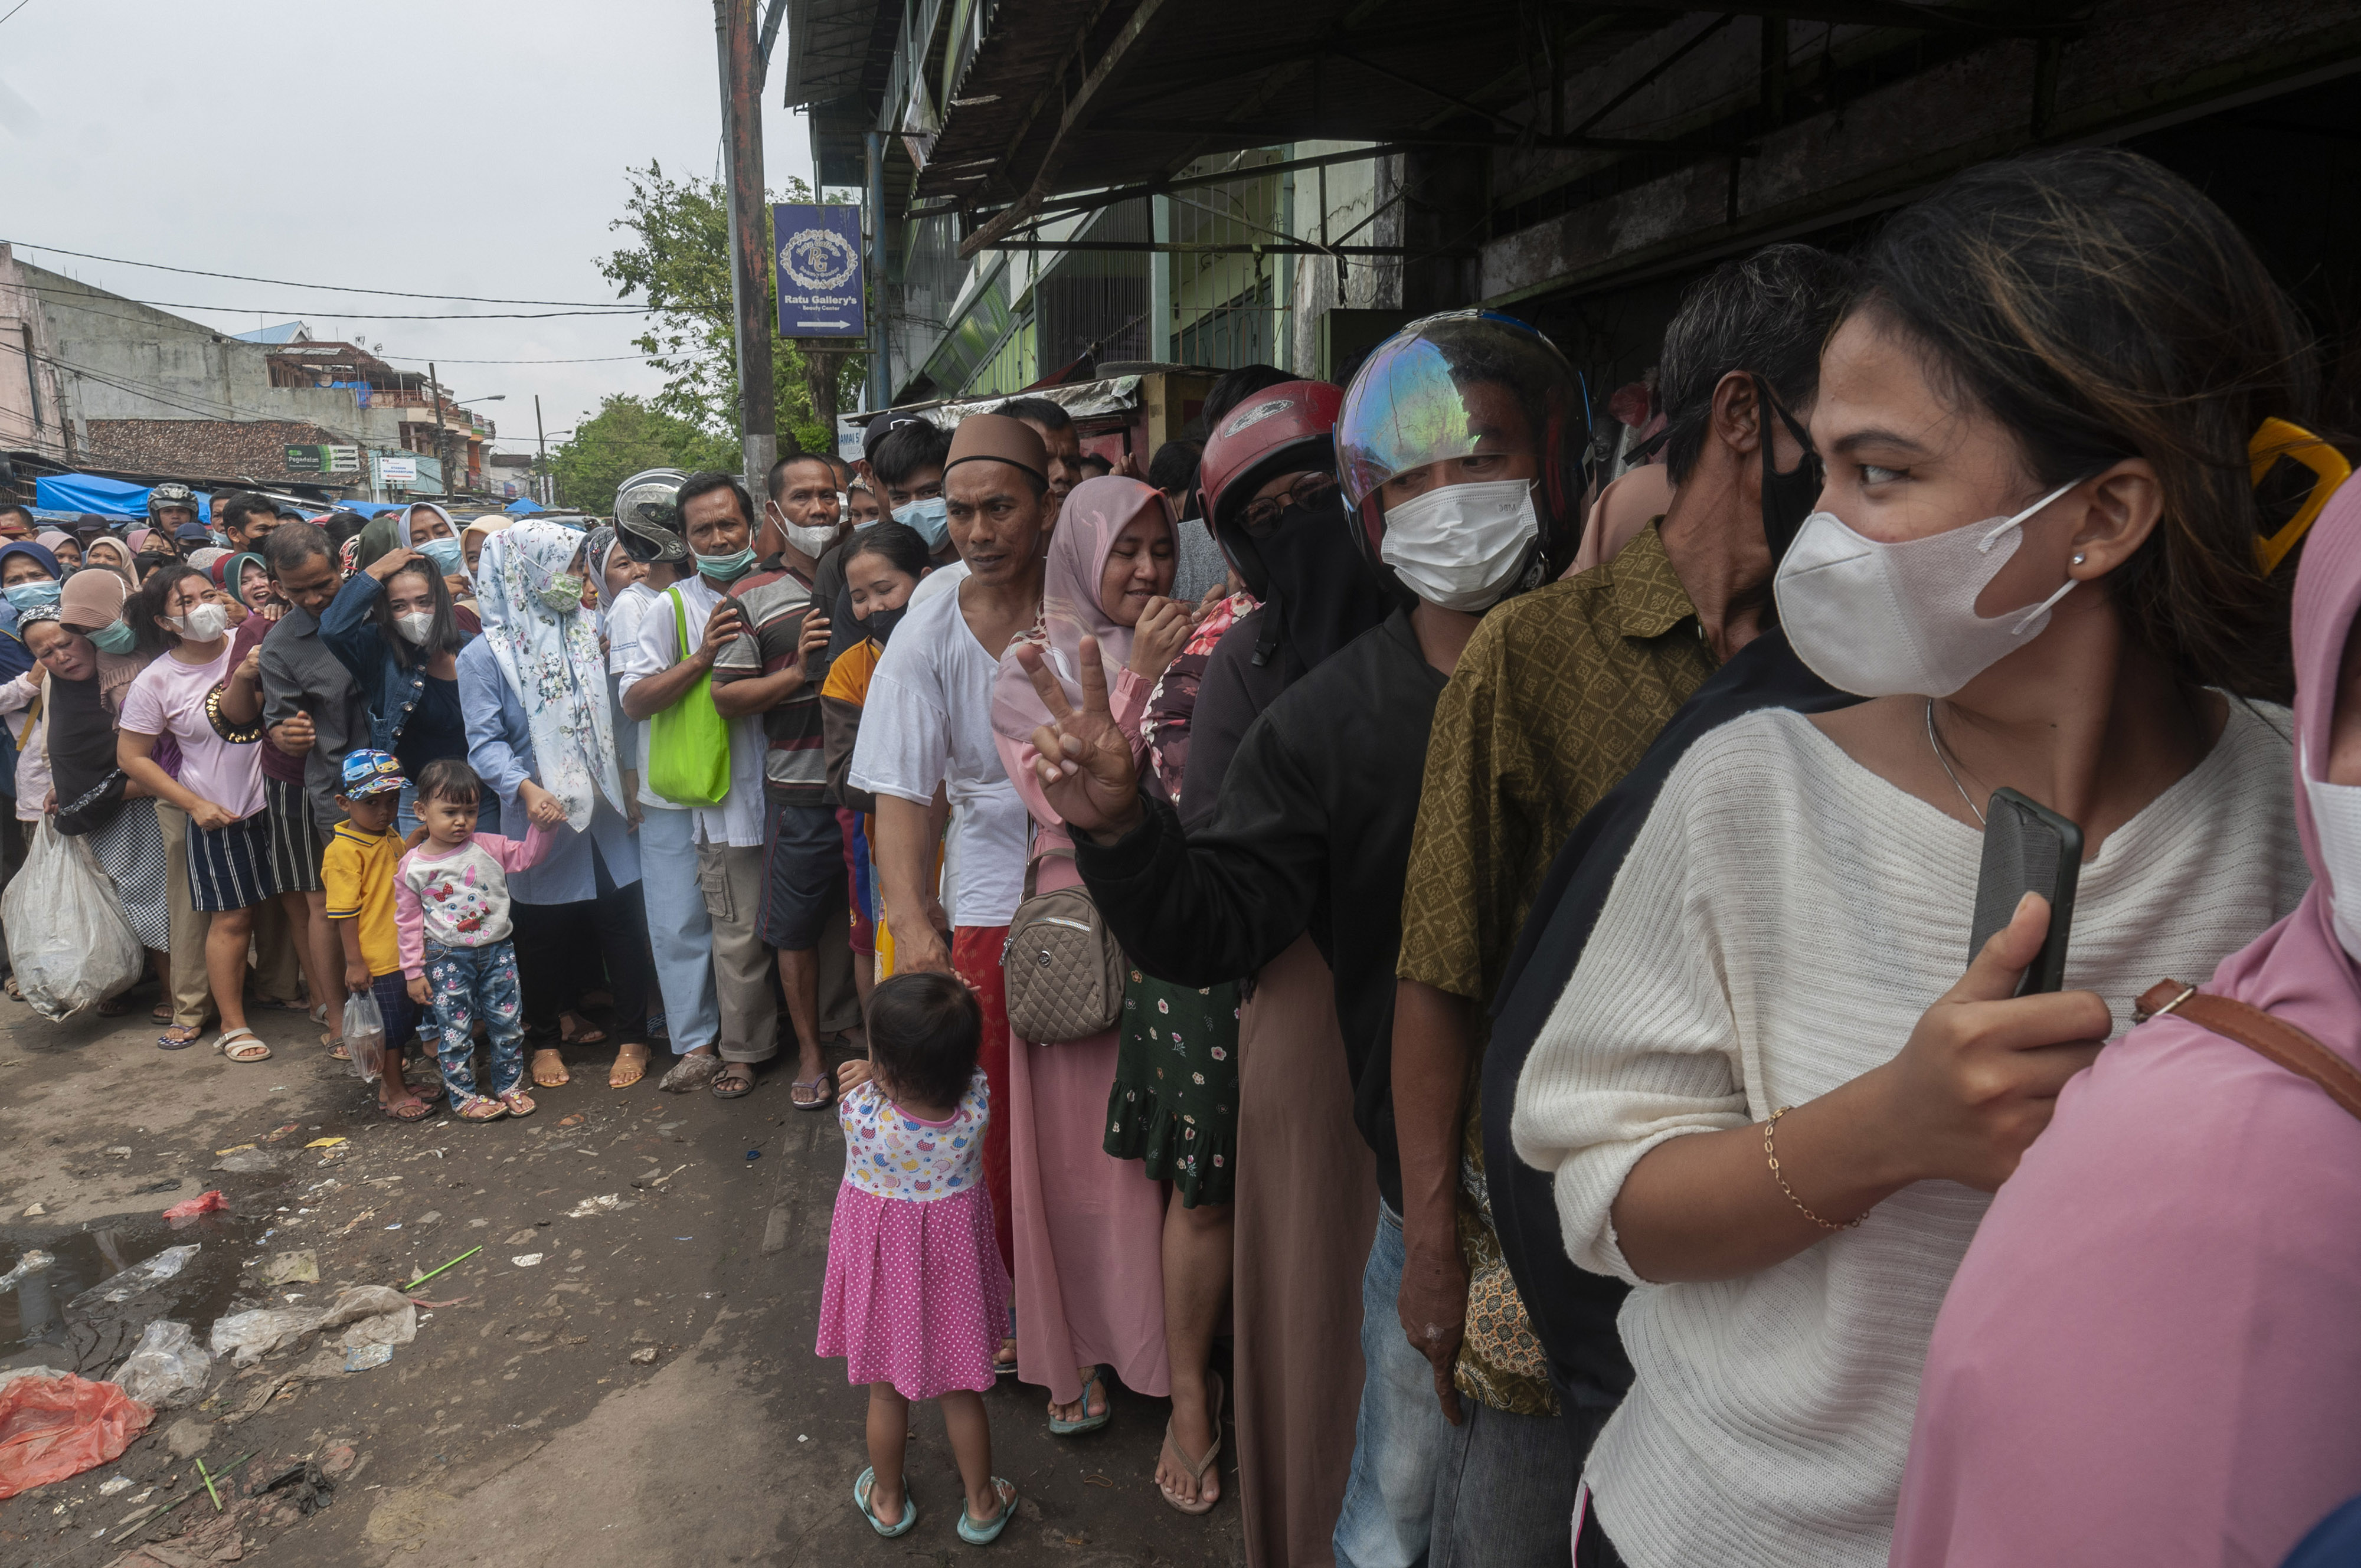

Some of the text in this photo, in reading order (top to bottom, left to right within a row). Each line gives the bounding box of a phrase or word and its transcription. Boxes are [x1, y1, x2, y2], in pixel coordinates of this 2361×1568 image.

[808, 247, 829, 272] RG
[784, 295, 857, 306] Ratu Gallery's
